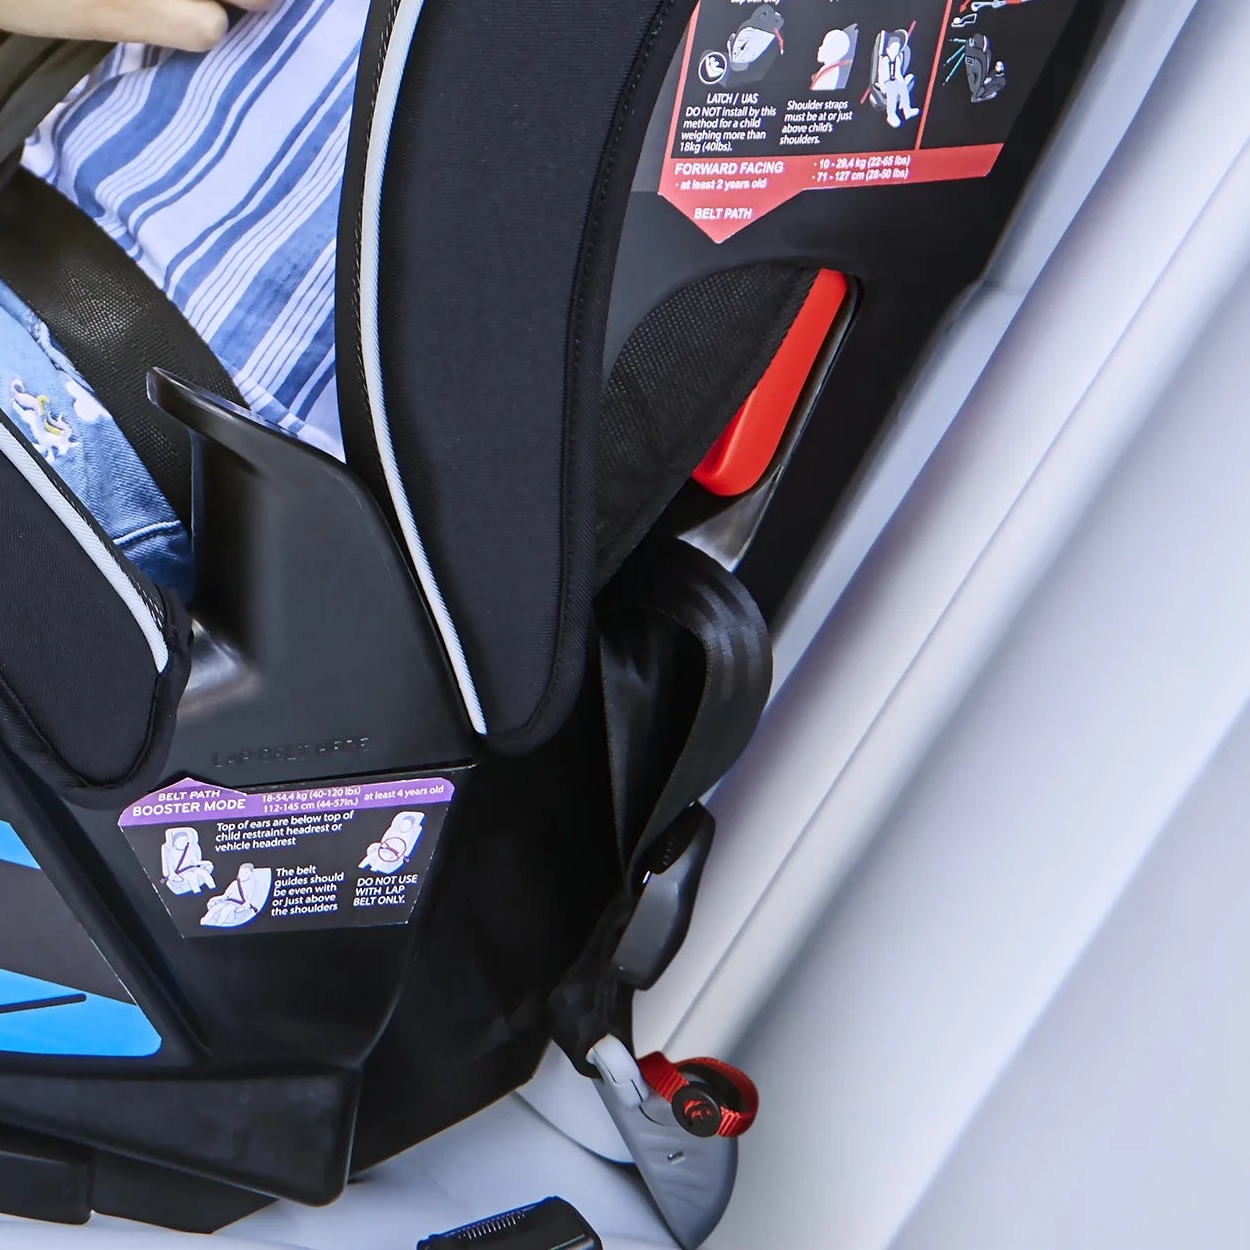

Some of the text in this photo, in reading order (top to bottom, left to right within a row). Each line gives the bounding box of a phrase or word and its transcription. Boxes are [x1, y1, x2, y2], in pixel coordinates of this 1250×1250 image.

[706, 93, 733, 104] LATCH
[741, 93, 758, 104] UAS
[786, 99, 848, 111] Shoulder straps
[685, 106, 776, 118] DO NOT install by this
[781, 123, 807, 132] above
[681, 129, 721, 142] weighing
[747, 129, 766, 139] than
[779, 134, 820, 144] shoulders.
[680, 140, 732, 154] 18kg (40lbs).
[674, 161, 783, 175] FORWARD FACING
[693, 208, 752, 219] BELT PATH
[158, 790, 220, 801] BELT PATH
[296, 790, 308, 801] kg
[309, 788, 343, 799] (40-120
[345, 786, 361, 795] lbs)
[364, 785, 444, 800] at least 4 years old
[132, 798, 246, 816] BOOSTER MODE
[264, 802, 299, 813] 112-145
[216, 809, 354, 833] Top of ears are below top of
[215, 823, 342, 842] child restraint headrest or
[215, 837, 296, 851] vehicle headrest
[276, 865, 316, 876] The belt
[274, 872, 344, 889] guides should
[357, 874, 417, 886] DO NOT USE
[273, 883, 336, 896] be even with
[355, 884, 405, 896] WITH LAP
[284, 896, 303, 907] just
[305, 894, 336, 903] above
[353, 894, 405, 906] BELT ONLY.
[271, 903, 337, 916] the shoulders
